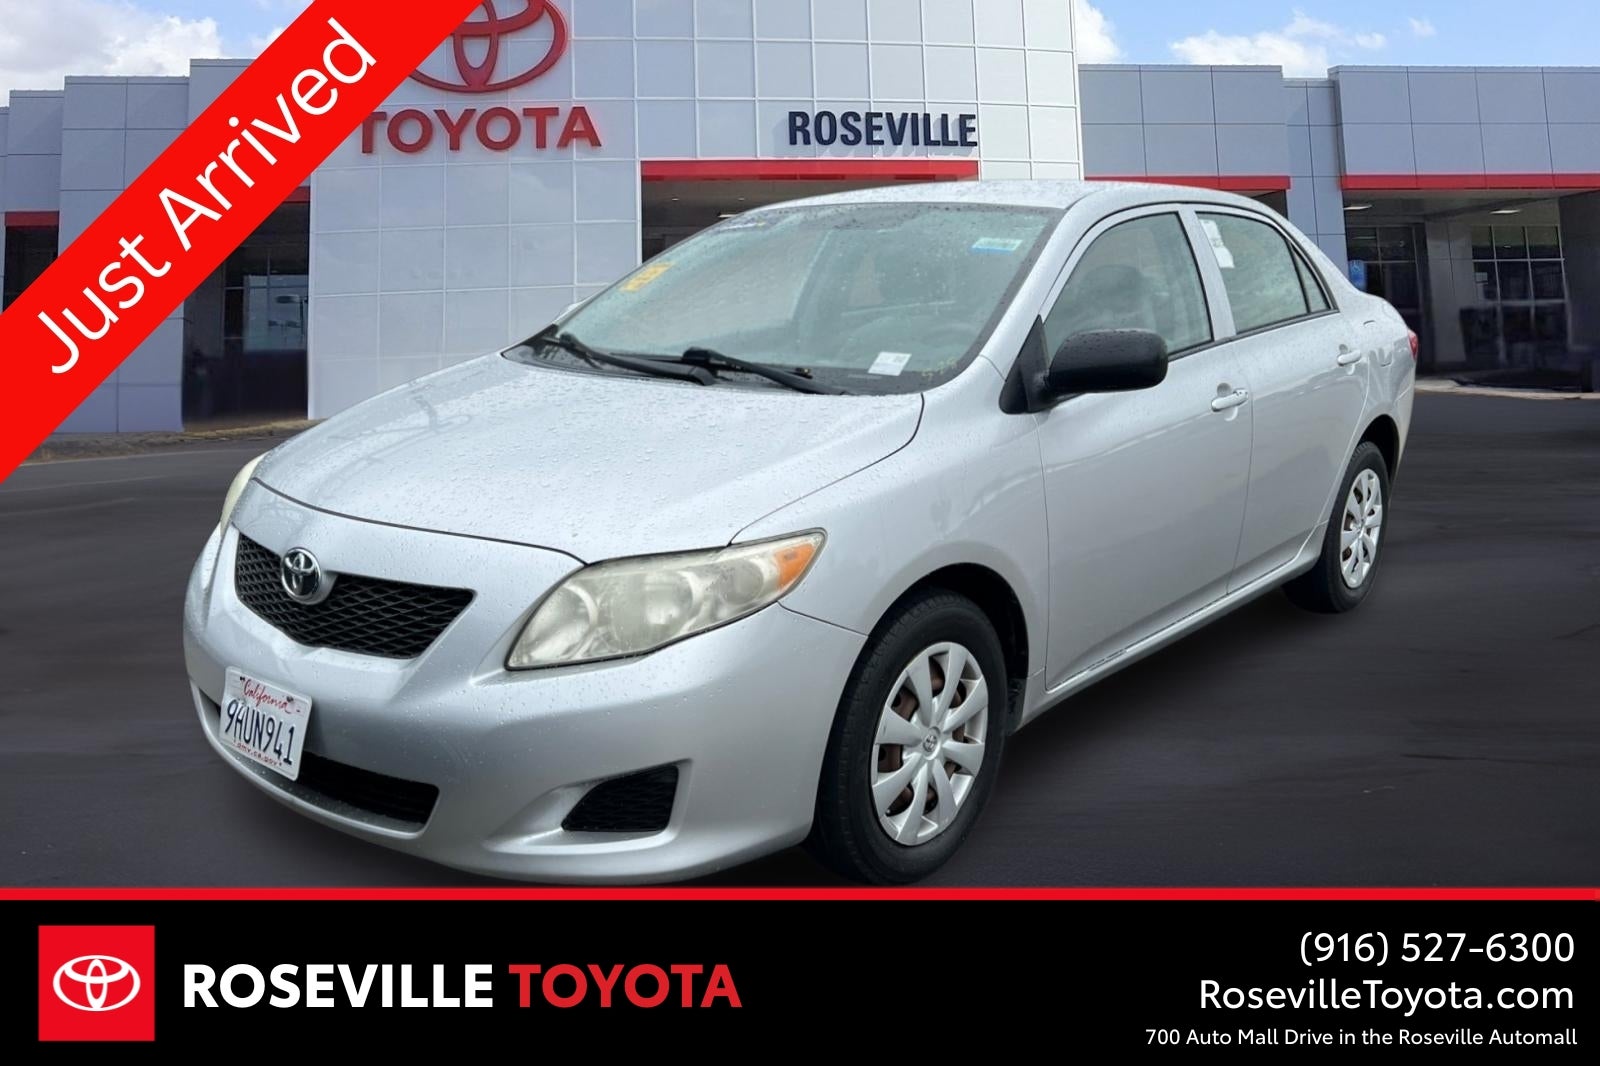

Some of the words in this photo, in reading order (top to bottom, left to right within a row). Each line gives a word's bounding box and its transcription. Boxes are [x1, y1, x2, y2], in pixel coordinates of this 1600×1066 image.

[361, 106, 602, 154] TOYOTA
[788, 110, 978, 147] ROSEVILLE
[243, 679, 291, 715] California
